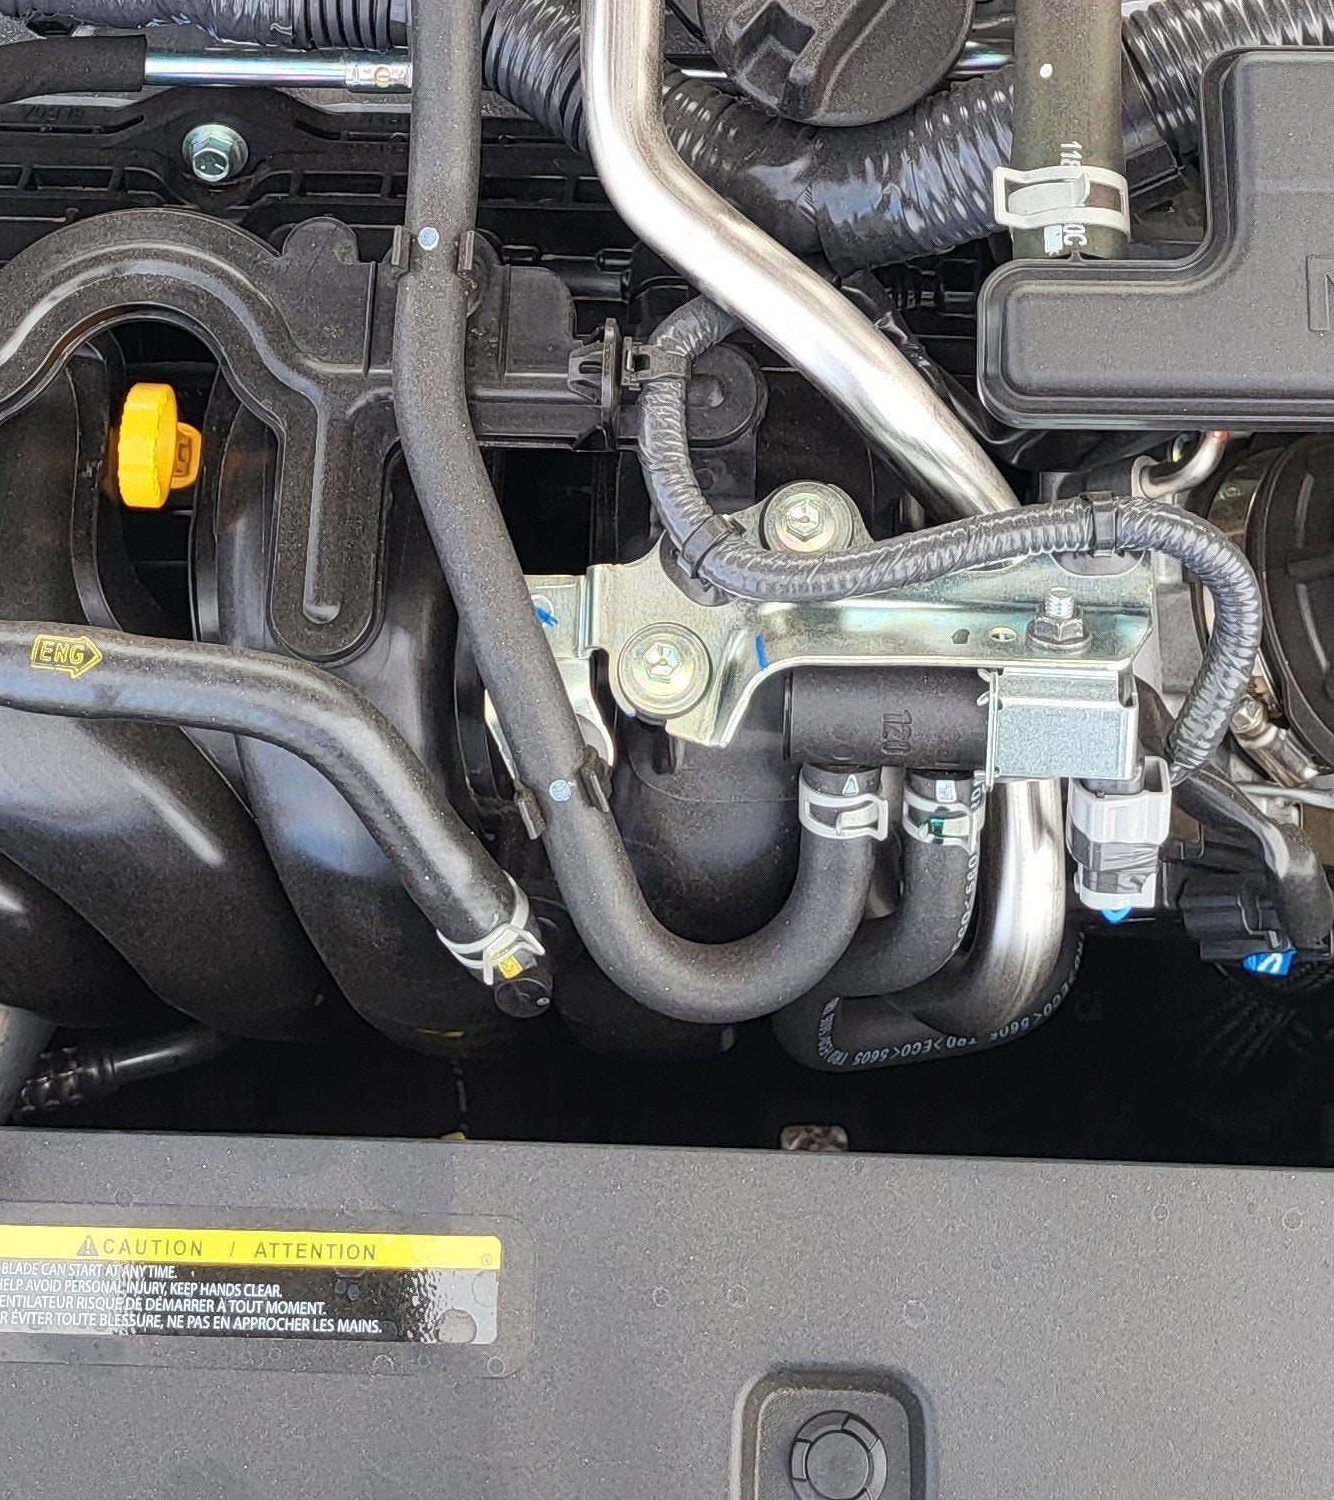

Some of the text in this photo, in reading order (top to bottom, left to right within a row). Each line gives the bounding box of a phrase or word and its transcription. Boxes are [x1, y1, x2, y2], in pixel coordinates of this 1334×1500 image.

[39, 641, 85, 665] ENG
[103, 1238, 203, 1258] CAUTION
[254, 1242, 377, 1261] ATTENTION
[1, 1262, 38, 1276] BLADE
[41, 1262, 66, 1276] CAN
[68, 1263, 104, 1277] START
[104, 1264, 120, 1277] AT
[26, 1279, 62, 1292] AVOID
[64, 1279, 124, 1294] PERSONAL
[126, 1281, 167, 1297] INJURY,
[170, 1282, 198, 1295] KEEP
[200, 1282, 241, 1297] HANDS
[244, 1283, 283, 1298] CLEAR.
[77, 1296, 123, 1311] RISQUE
[126, 1297, 142, 1311] DE
[147, 1296, 215, 1313] DÉMARRER
[216, 1296, 227, 1312] À
[228, 1299, 264, 1314] TOUT
[266, 1300, 327, 1315] MOMENT.
[10, 1308, 53, 1325] ÉVITER
[56, 1312, 97, 1326] TOUTE
[99, 1313, 164, 1330] BLESSURE,
[167, 1315, 185, 1328] NE
[186, 1315, 210, 1329] PAS
[212, 1316, 231, 1329] EN
[232, 1316, 312, 1331] APPROCHER
[313, 1318, 334, 1332] LES
[337, 1318, 382, 1334] MAINS.
